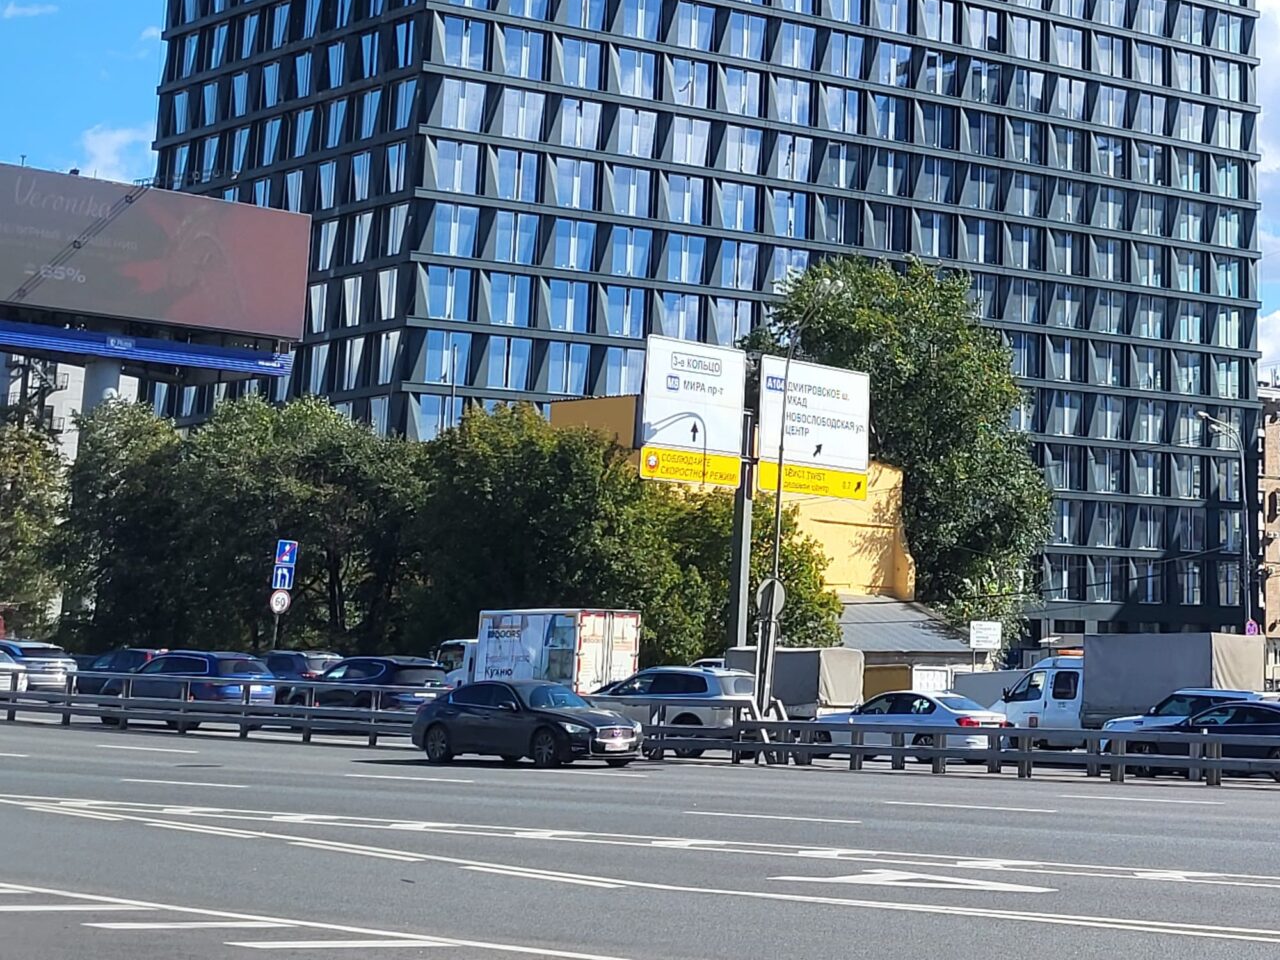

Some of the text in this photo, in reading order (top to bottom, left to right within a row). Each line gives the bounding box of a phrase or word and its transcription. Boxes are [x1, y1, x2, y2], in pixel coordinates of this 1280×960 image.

[14, 175, 111, 219] Veronika
[686, 359, 721, 374] КОЛЬЦО
[683, 380, 724, 396] МИРА пр-т
[787, 381, 841, 399] ДМИТРОВСКОЕ
[786, 395, 808, 408] МКАД
[786, 411, 855, 431] НОВОСЛОБОДСКАЯ
[785, 425, 810, 437] ЦЕНТР
[275, 596, 286, 608] 60
